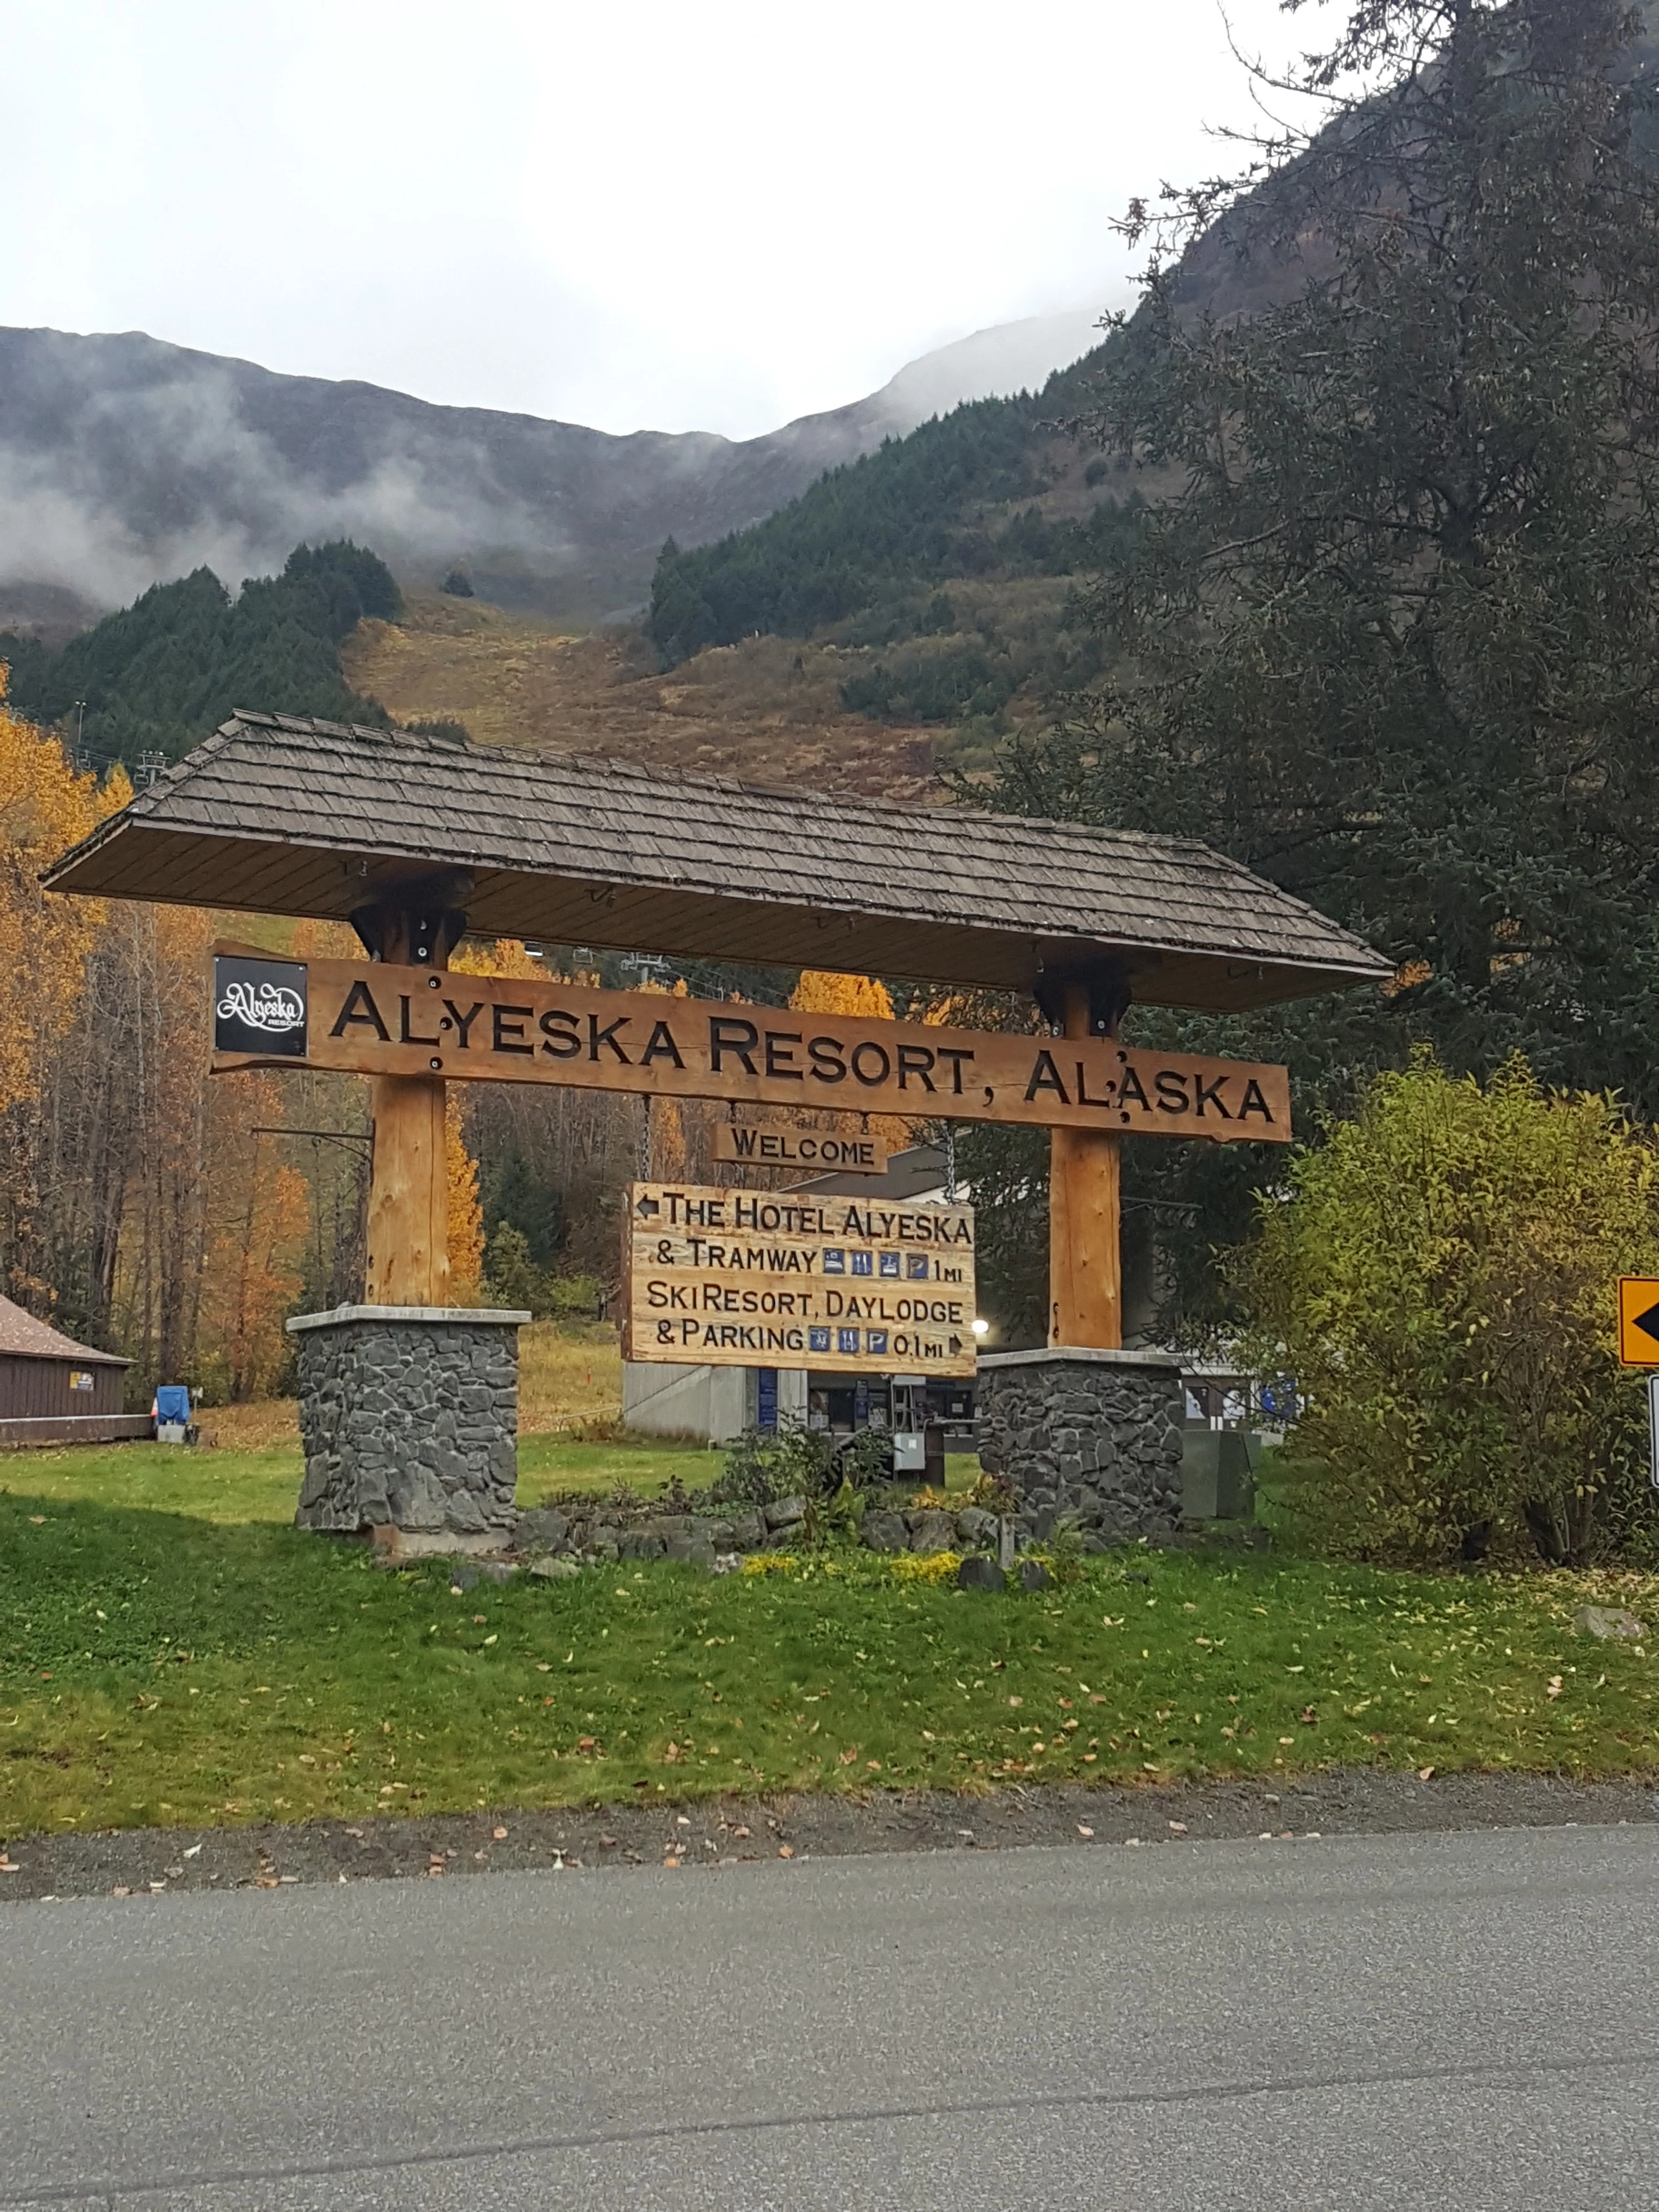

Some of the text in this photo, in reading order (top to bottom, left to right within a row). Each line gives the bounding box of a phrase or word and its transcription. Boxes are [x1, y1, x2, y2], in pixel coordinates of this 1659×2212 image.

[217, 982, 304, 1032] Alyeska
[268, 1019, 305, 1027] RESORT
[328, 980, 1277, 1123] ALYESKA RESORT, ALASKA
[731, 1128, 876, 1165] WELCOME
[662, 1191, 973, 1244] THE HOTEL ALYESKA
[657, 1239, 675, 1265] &
[686, 1238, 818, 1273] TRAMWAY
[646, 1280, 697, 1310] SKI
[702, 1283, 819, 1320] RESORT,
[656, 1319, 675, 1345] &
[681, 1318, 803, 1351] PARKING
